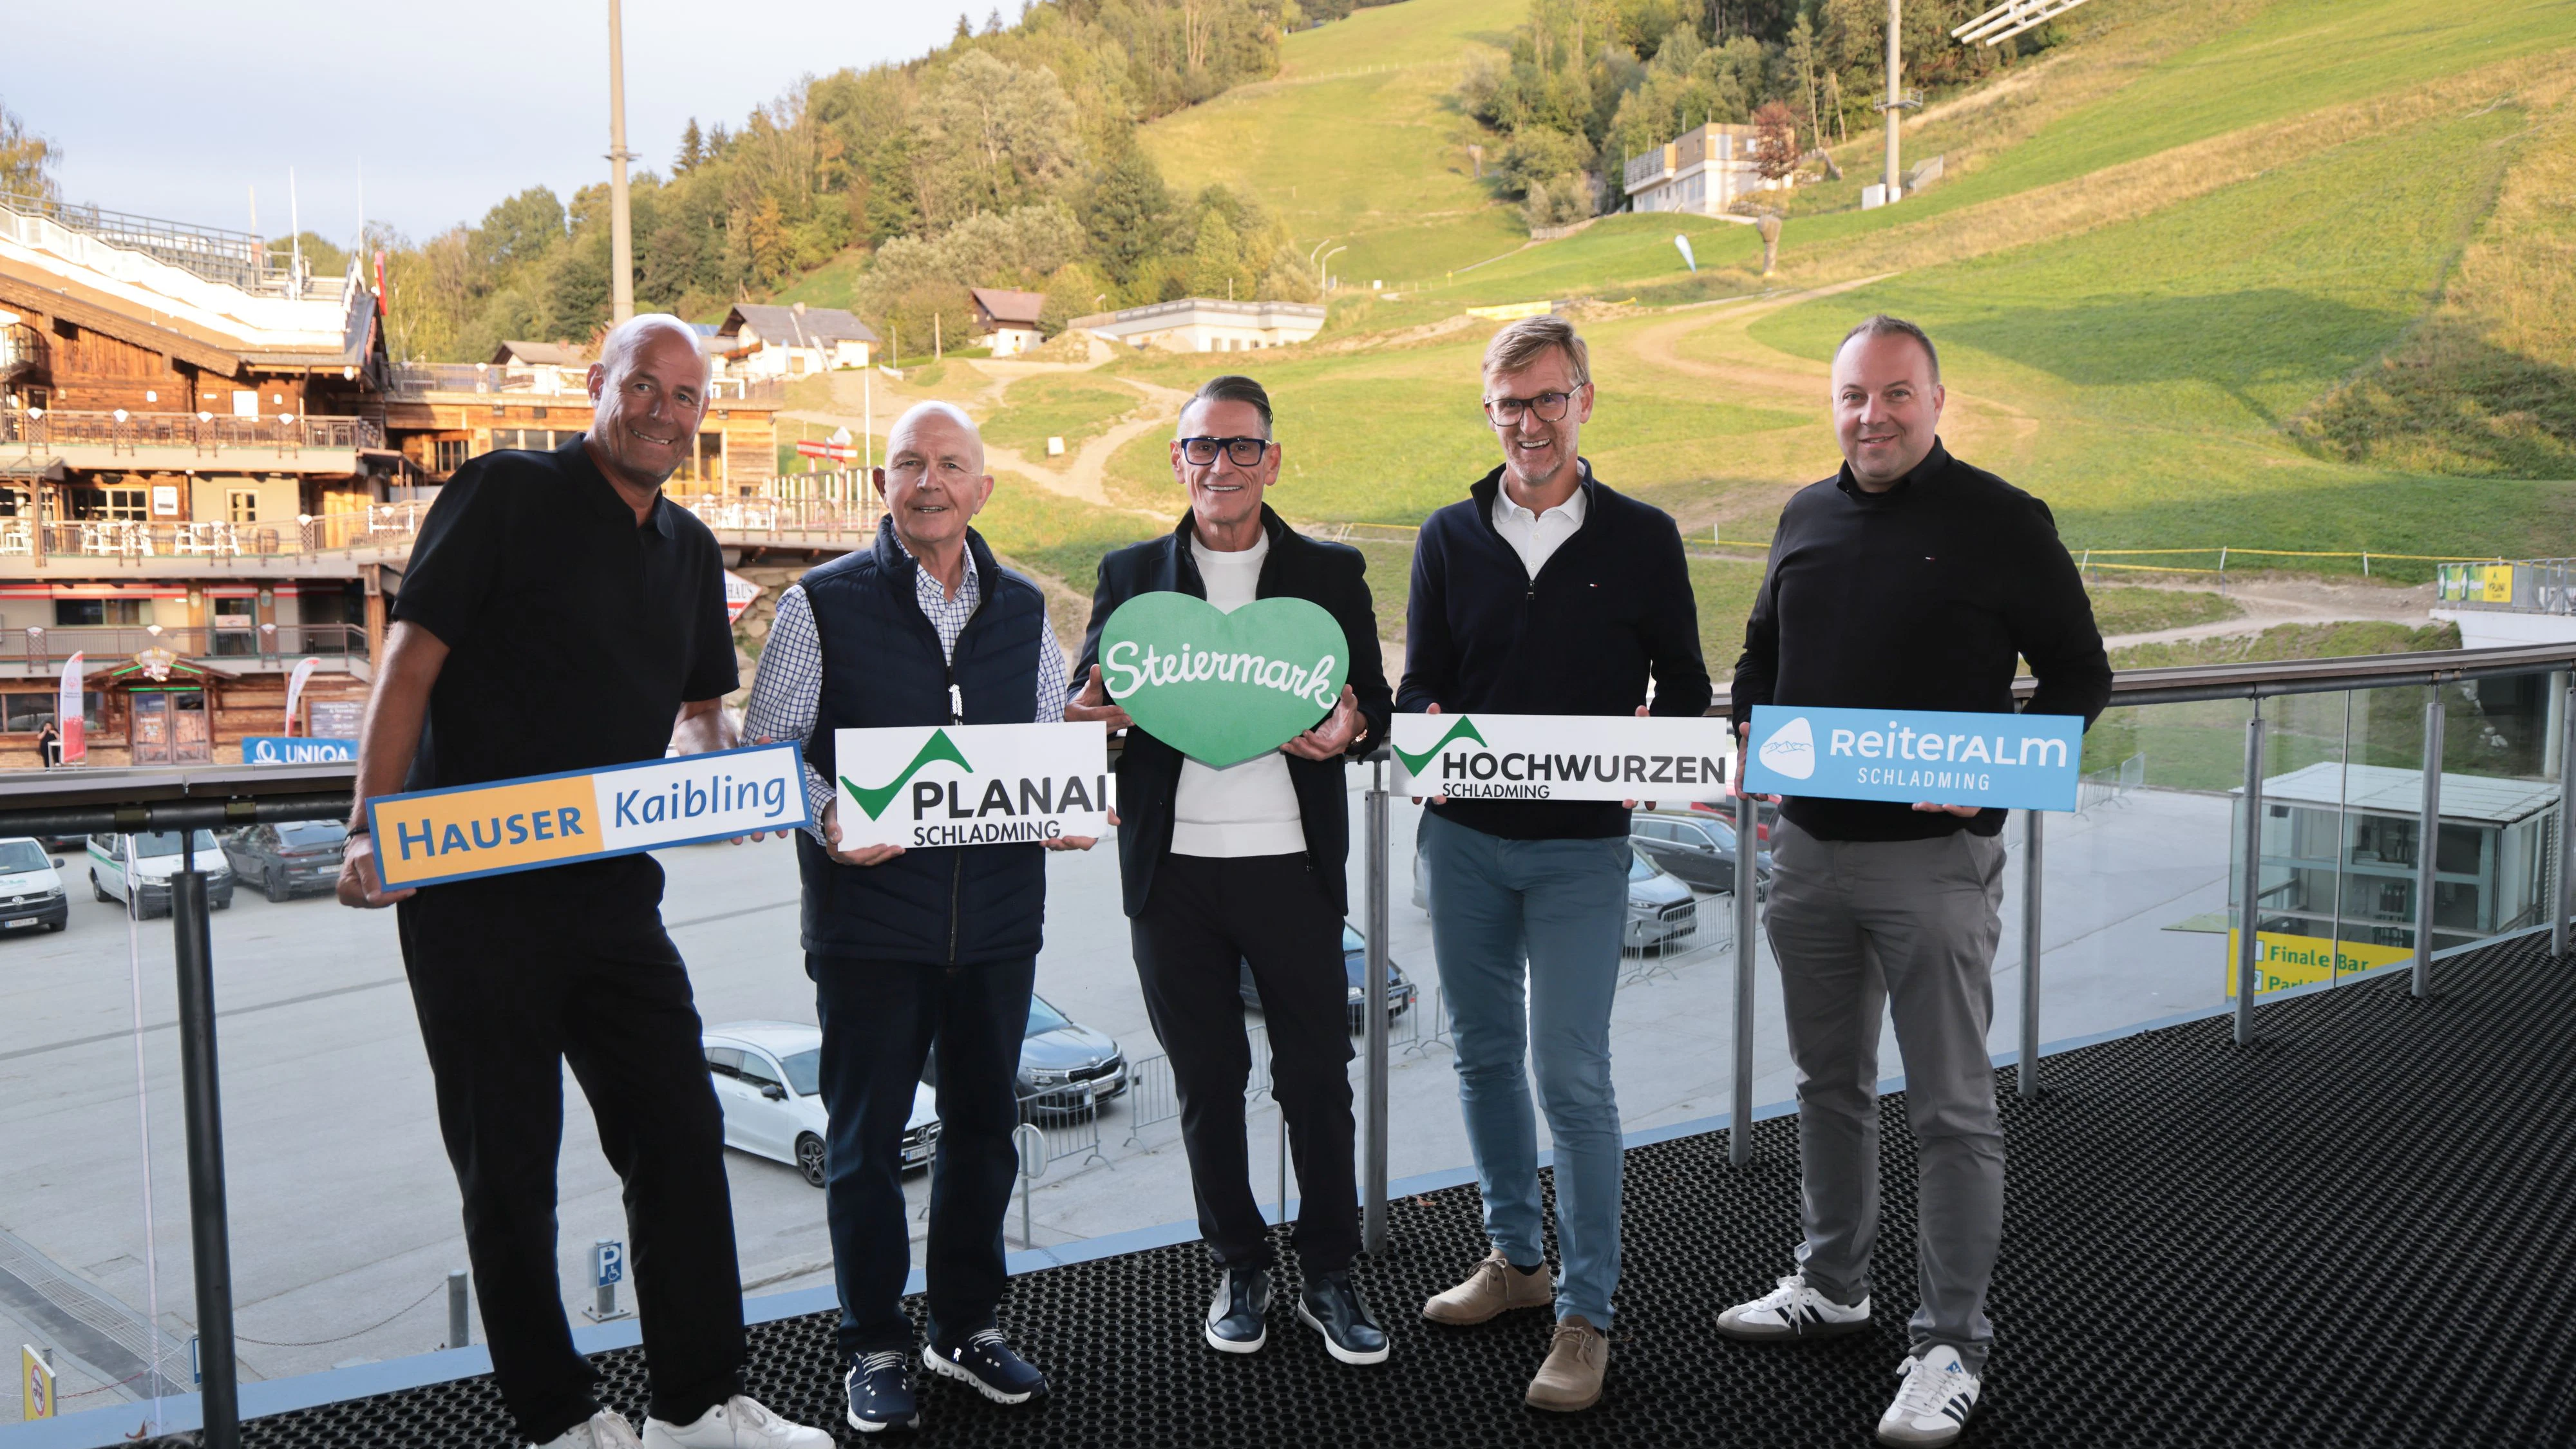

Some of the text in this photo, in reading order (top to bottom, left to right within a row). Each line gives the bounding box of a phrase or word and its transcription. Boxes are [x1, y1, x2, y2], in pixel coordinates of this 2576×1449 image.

[1104, 641, 1338, 710] Steiermark
[285, 744, 348, 763] UNIQA
[1443, 752, 1725, 784] HOCHWURZEN
[1442, 782, 1551, 799] SCHLADMING
[1857, 766, 1990, 791] SCHLADMING
[913, 774, 1106, 821] PLANAI
[397, 775, 786, 861] HAUSER Kaibling
[913, 819, 1061, 847] SCHLADMING
[2269, 945, 2370, 972] Finale Bar
[599, 1244, 621, 1278] P
